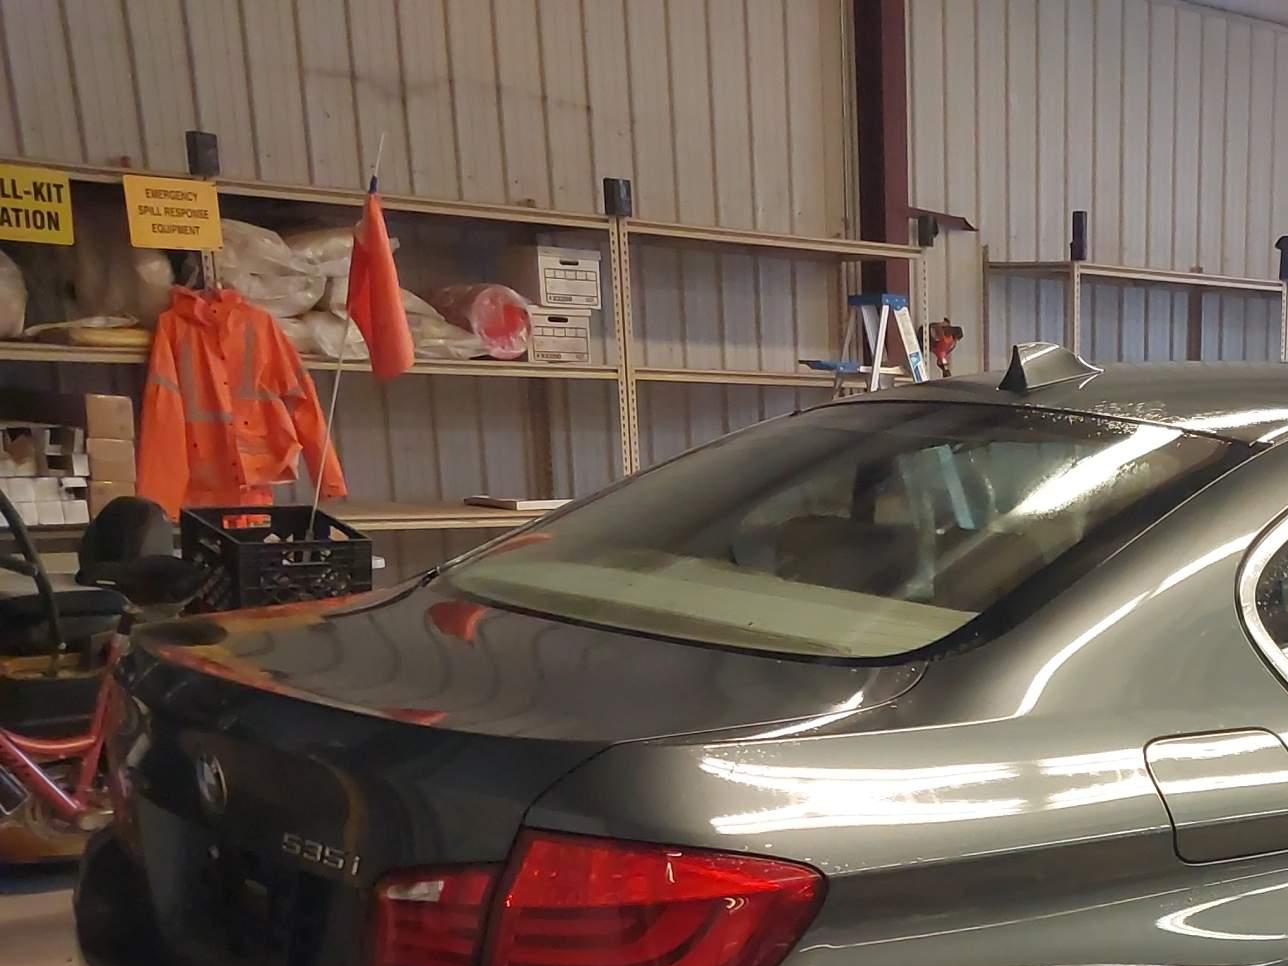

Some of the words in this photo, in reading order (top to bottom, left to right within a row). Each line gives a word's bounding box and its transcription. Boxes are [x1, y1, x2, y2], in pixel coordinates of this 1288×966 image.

[0, 178, 64, 203] LL-KIT
[145, 188, 197, 201] EMERGENCY
[0, 207, 60, 231] ATION
[138, 205, 162, 216] SPILL
[164, 207, 208, 219] RESPONSE
[152, 223, 200, 235] EQUIPMENT
[282, 832, 361, 876] 535i
